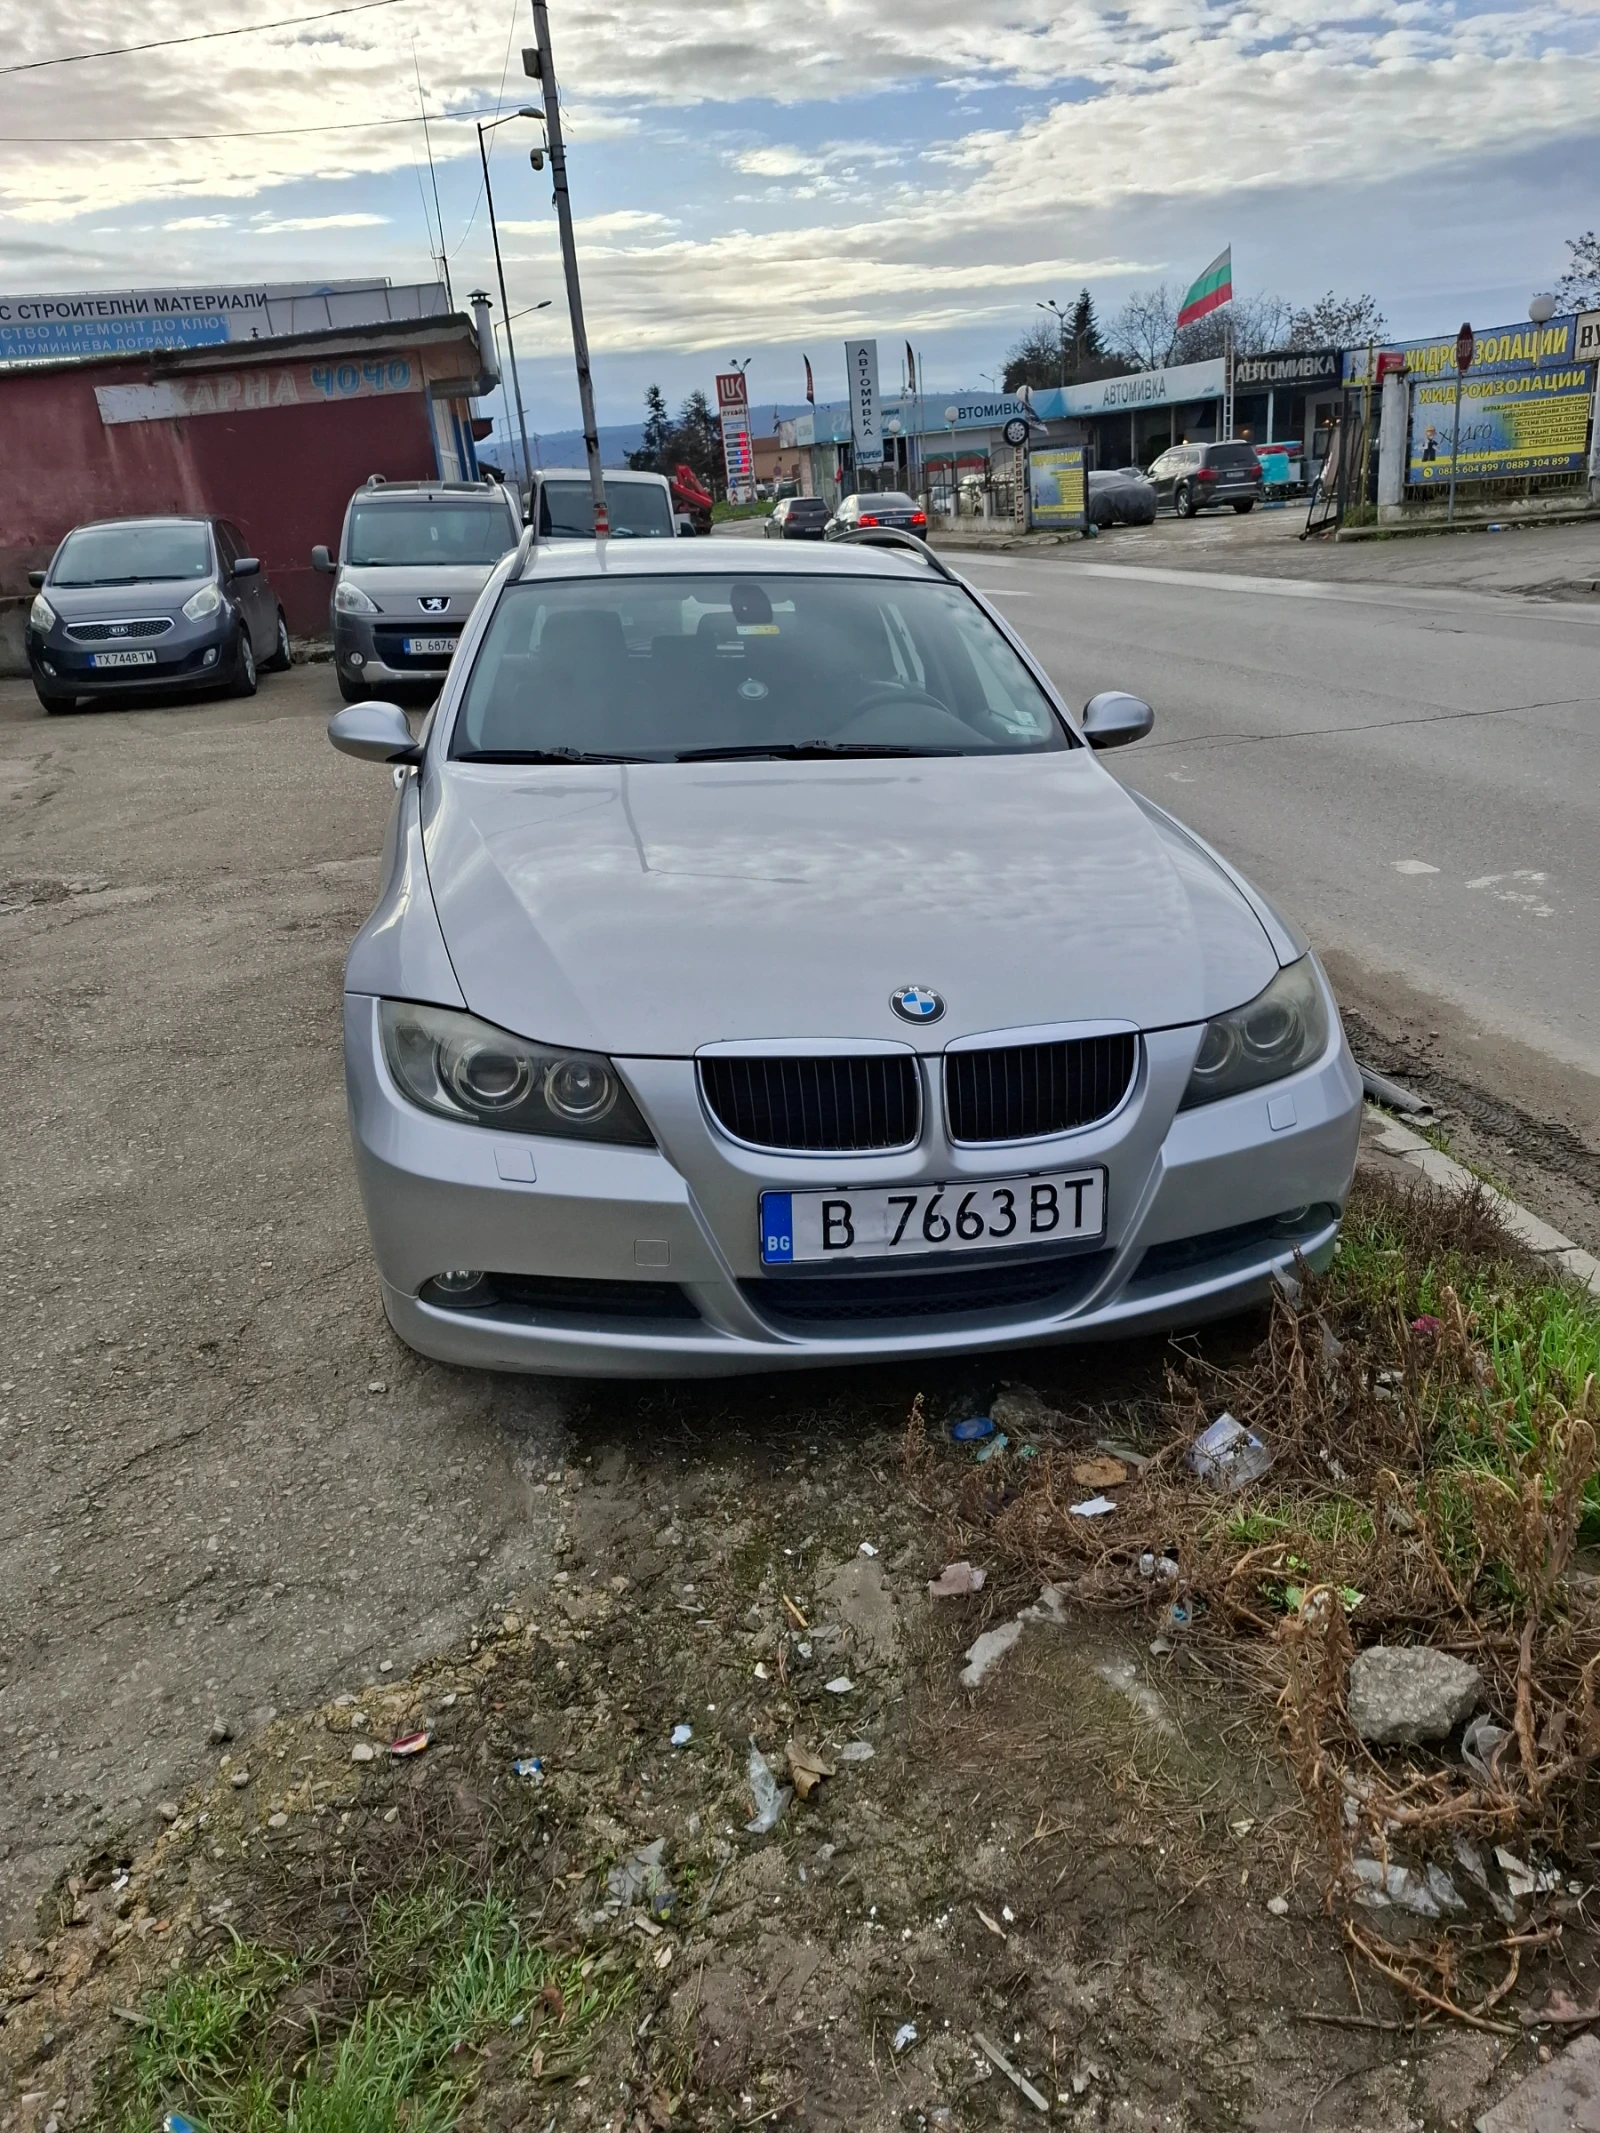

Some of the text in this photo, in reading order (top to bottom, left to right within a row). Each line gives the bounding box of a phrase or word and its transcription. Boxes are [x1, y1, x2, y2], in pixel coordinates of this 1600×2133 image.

[18, 299, 149, 319] СТРОИТЕЛНИ
[154, 293, 267, 312] МАТЕРИАЛИ
[1, 316, 231, 340] СТВО И РЕМОНТ ДО КЛЮЧ
[7, 340, 112, 355] АЛУМИНИЕВА
[117, 336, 186, 351] ДОГРАМА
[1406, 326, 1569, 377] ХИДРОЗОЛАЦИИ
[1457, 339, 1472, 357] STOP
[310, 358, 412, 397] ЧОЧО
[1235, 355, 1336, 383] АВТОМИВКА
[858, 348, 873, 436] АВТОМИВКА
[1103, 376, 1166, 406] АВТОМИВКА
[1419, 370, 1586, 405] ХИДРОИЗОЛАЦИИ
[958, 401, 1026, 419] ВТОМИВК
[1462, 465, 1479, 473] 604
[1481, 463, 1499, 472] 899
[1506, 460, 1530, 470] 0889
[1531, 458, 1549, 467] 304
[1551, 456, 1570, 466] 899
[1016, 495, 1025, 524] ГУМИ
[894, 986, 938, 999] BMW
[767, 1236, 791, 1252] BG
